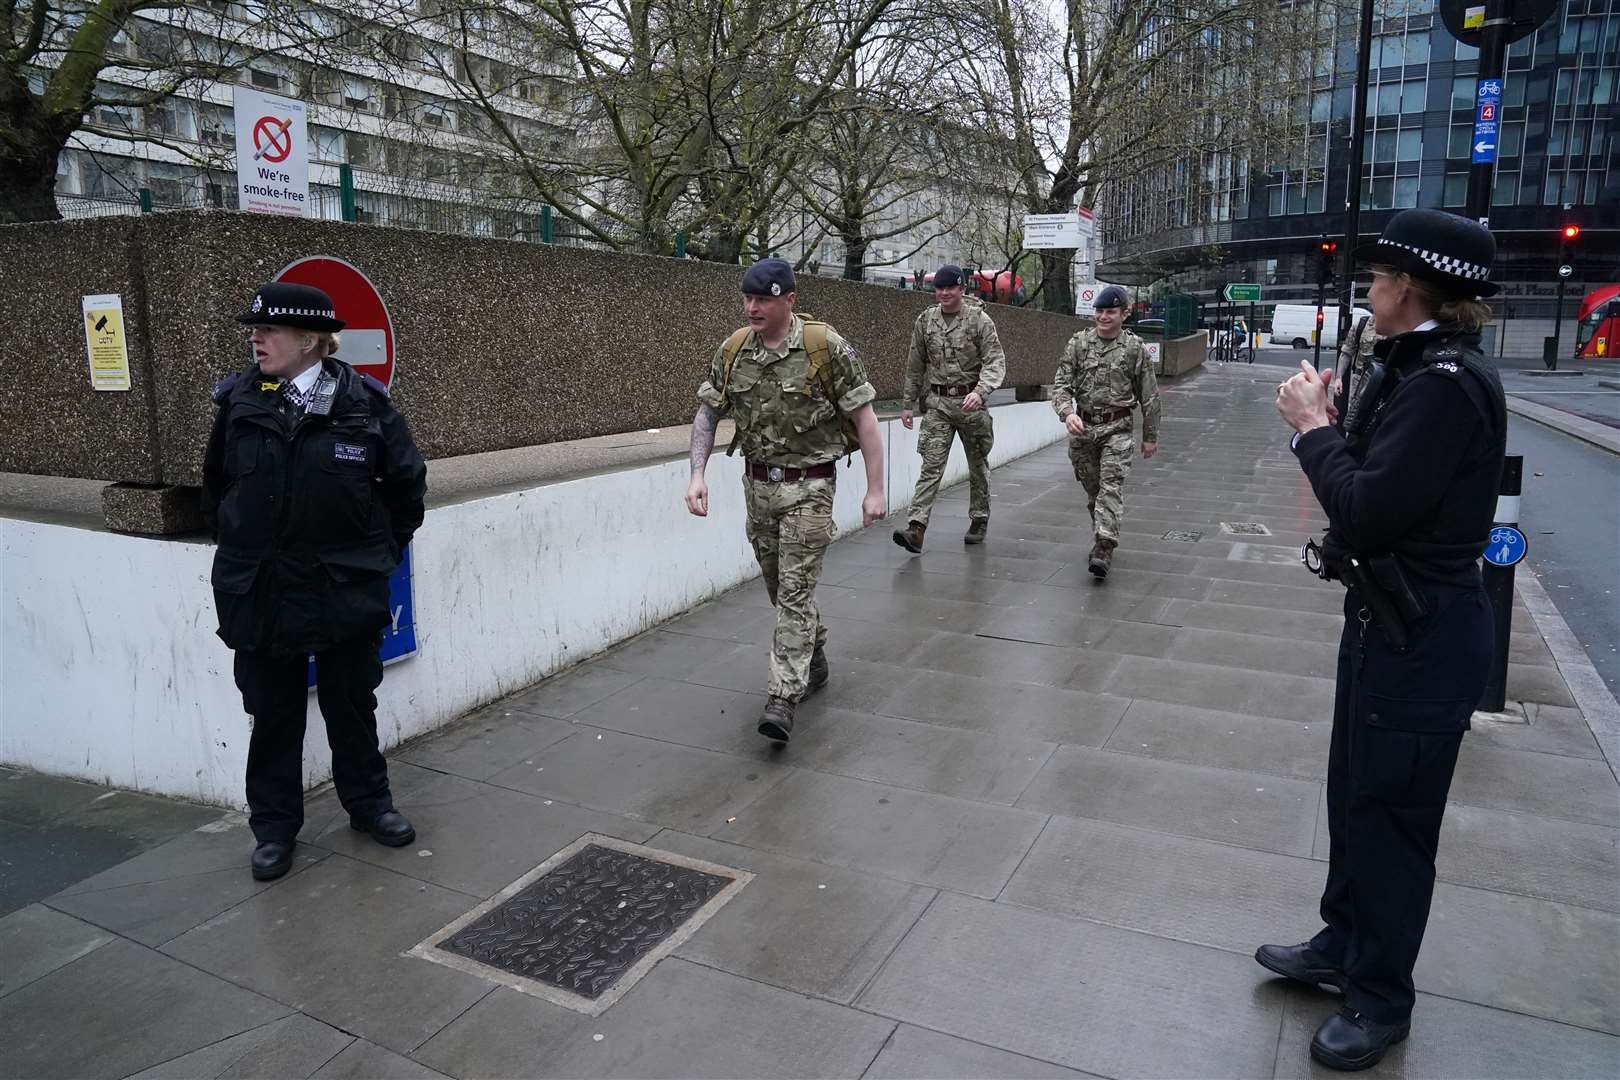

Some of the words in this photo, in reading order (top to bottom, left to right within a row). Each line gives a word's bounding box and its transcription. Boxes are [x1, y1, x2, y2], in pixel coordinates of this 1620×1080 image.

[1484, 108, 1492, 118] 4
[257, 167, 290, 183] We're
[243, 184, 305, 202] smoke-free
[1526, 284, 1555, 296] Plaza
